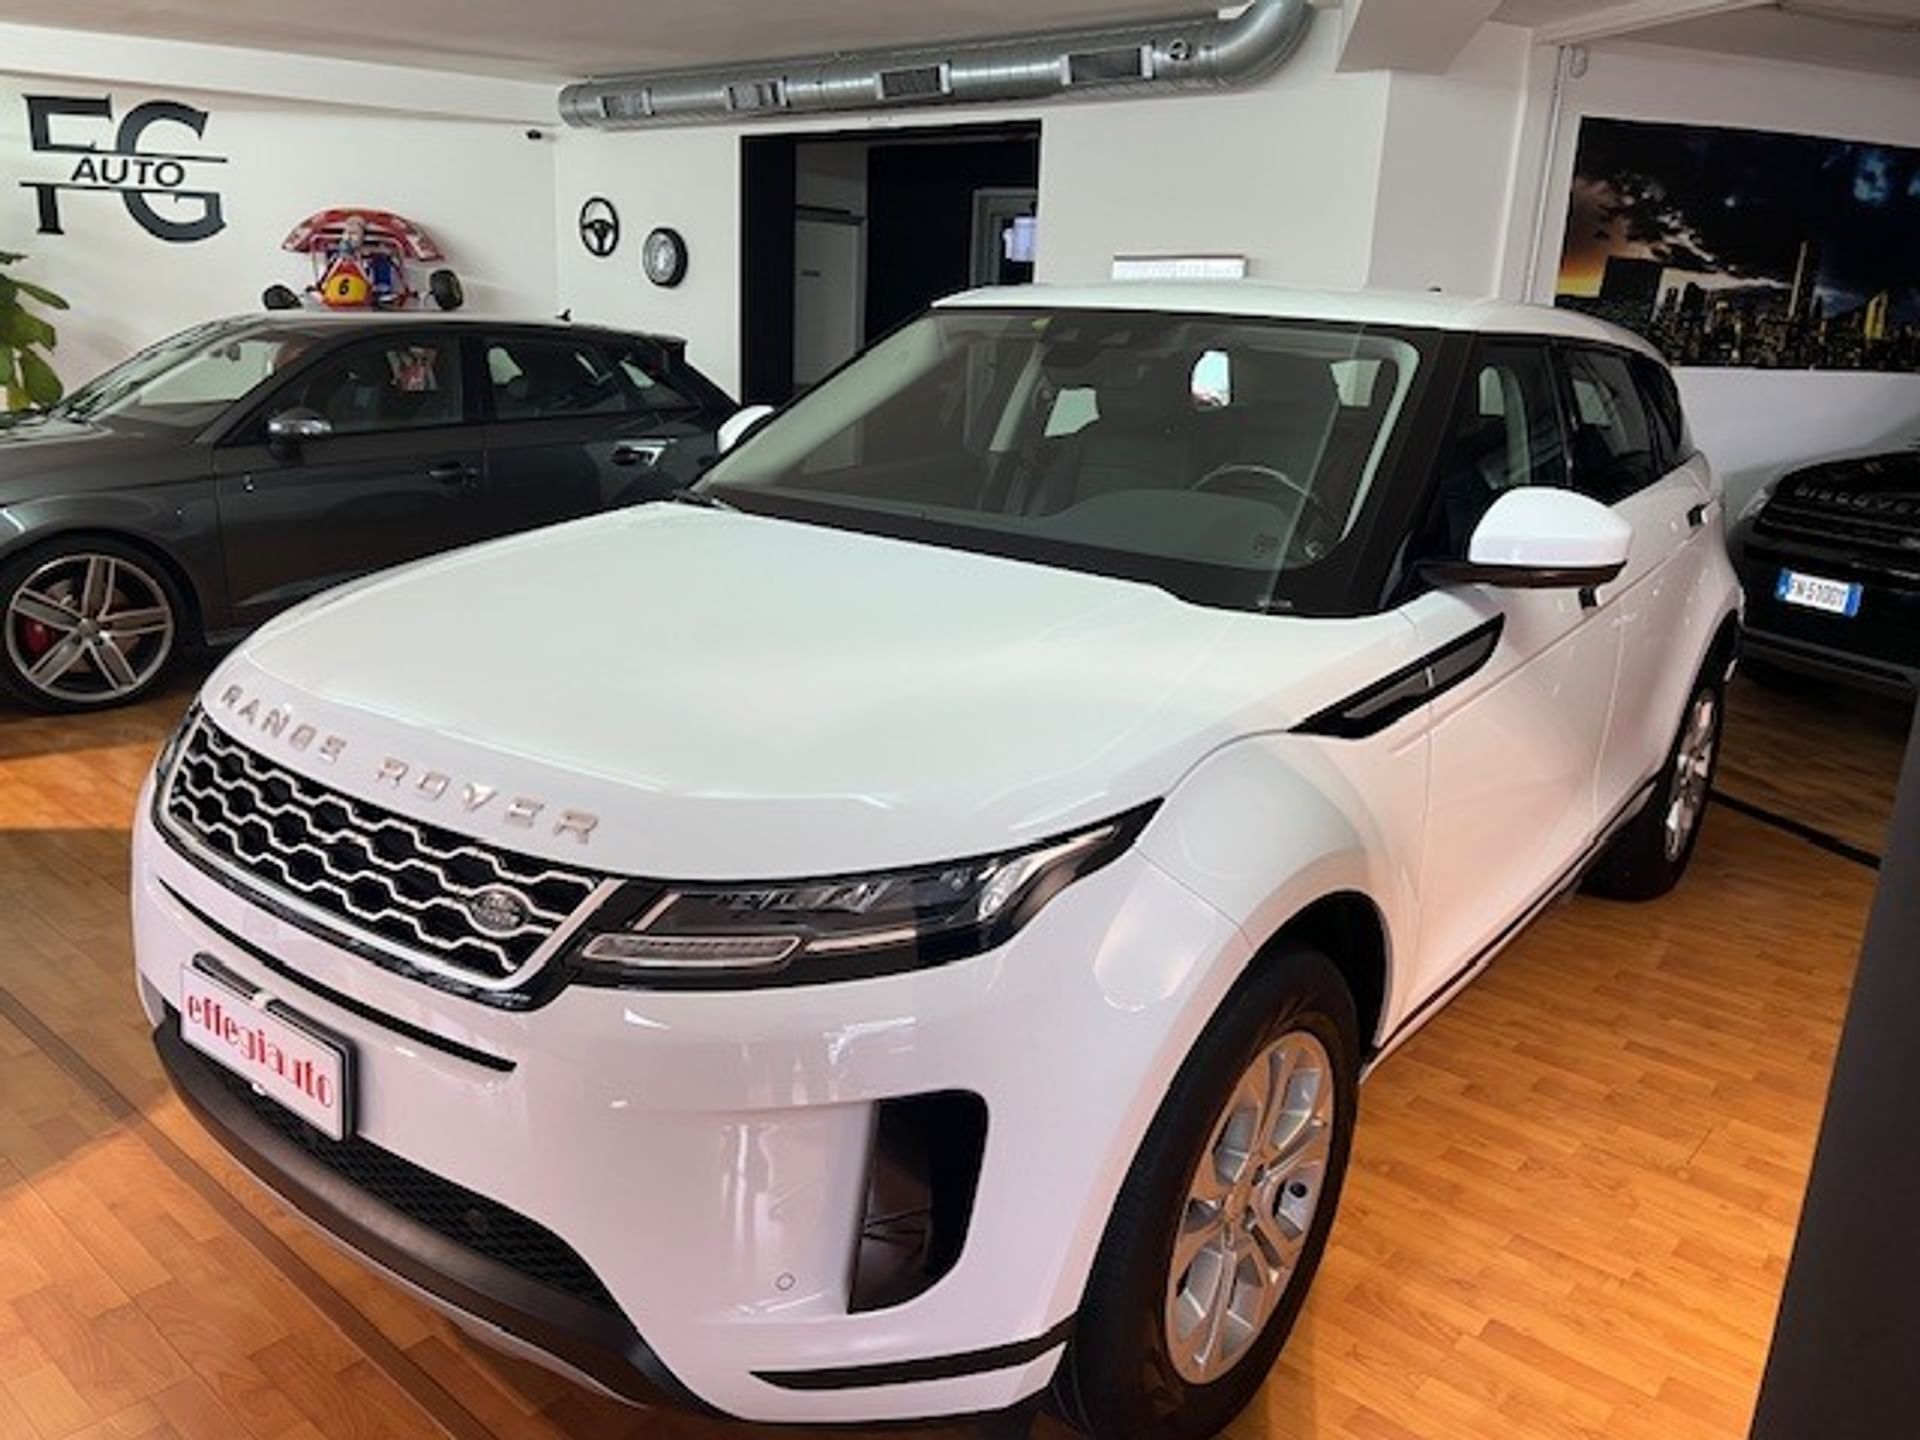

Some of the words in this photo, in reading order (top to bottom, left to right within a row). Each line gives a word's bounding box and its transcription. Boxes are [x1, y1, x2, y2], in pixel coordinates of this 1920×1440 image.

[71, 157, 186, 188] AUTO
[338, 279, 350, 295] 6
[219, 684, 347, 764] RANGE
[376, 757, 599, 845] ROVER
[187, 994, 334, 1108] effegiauto
